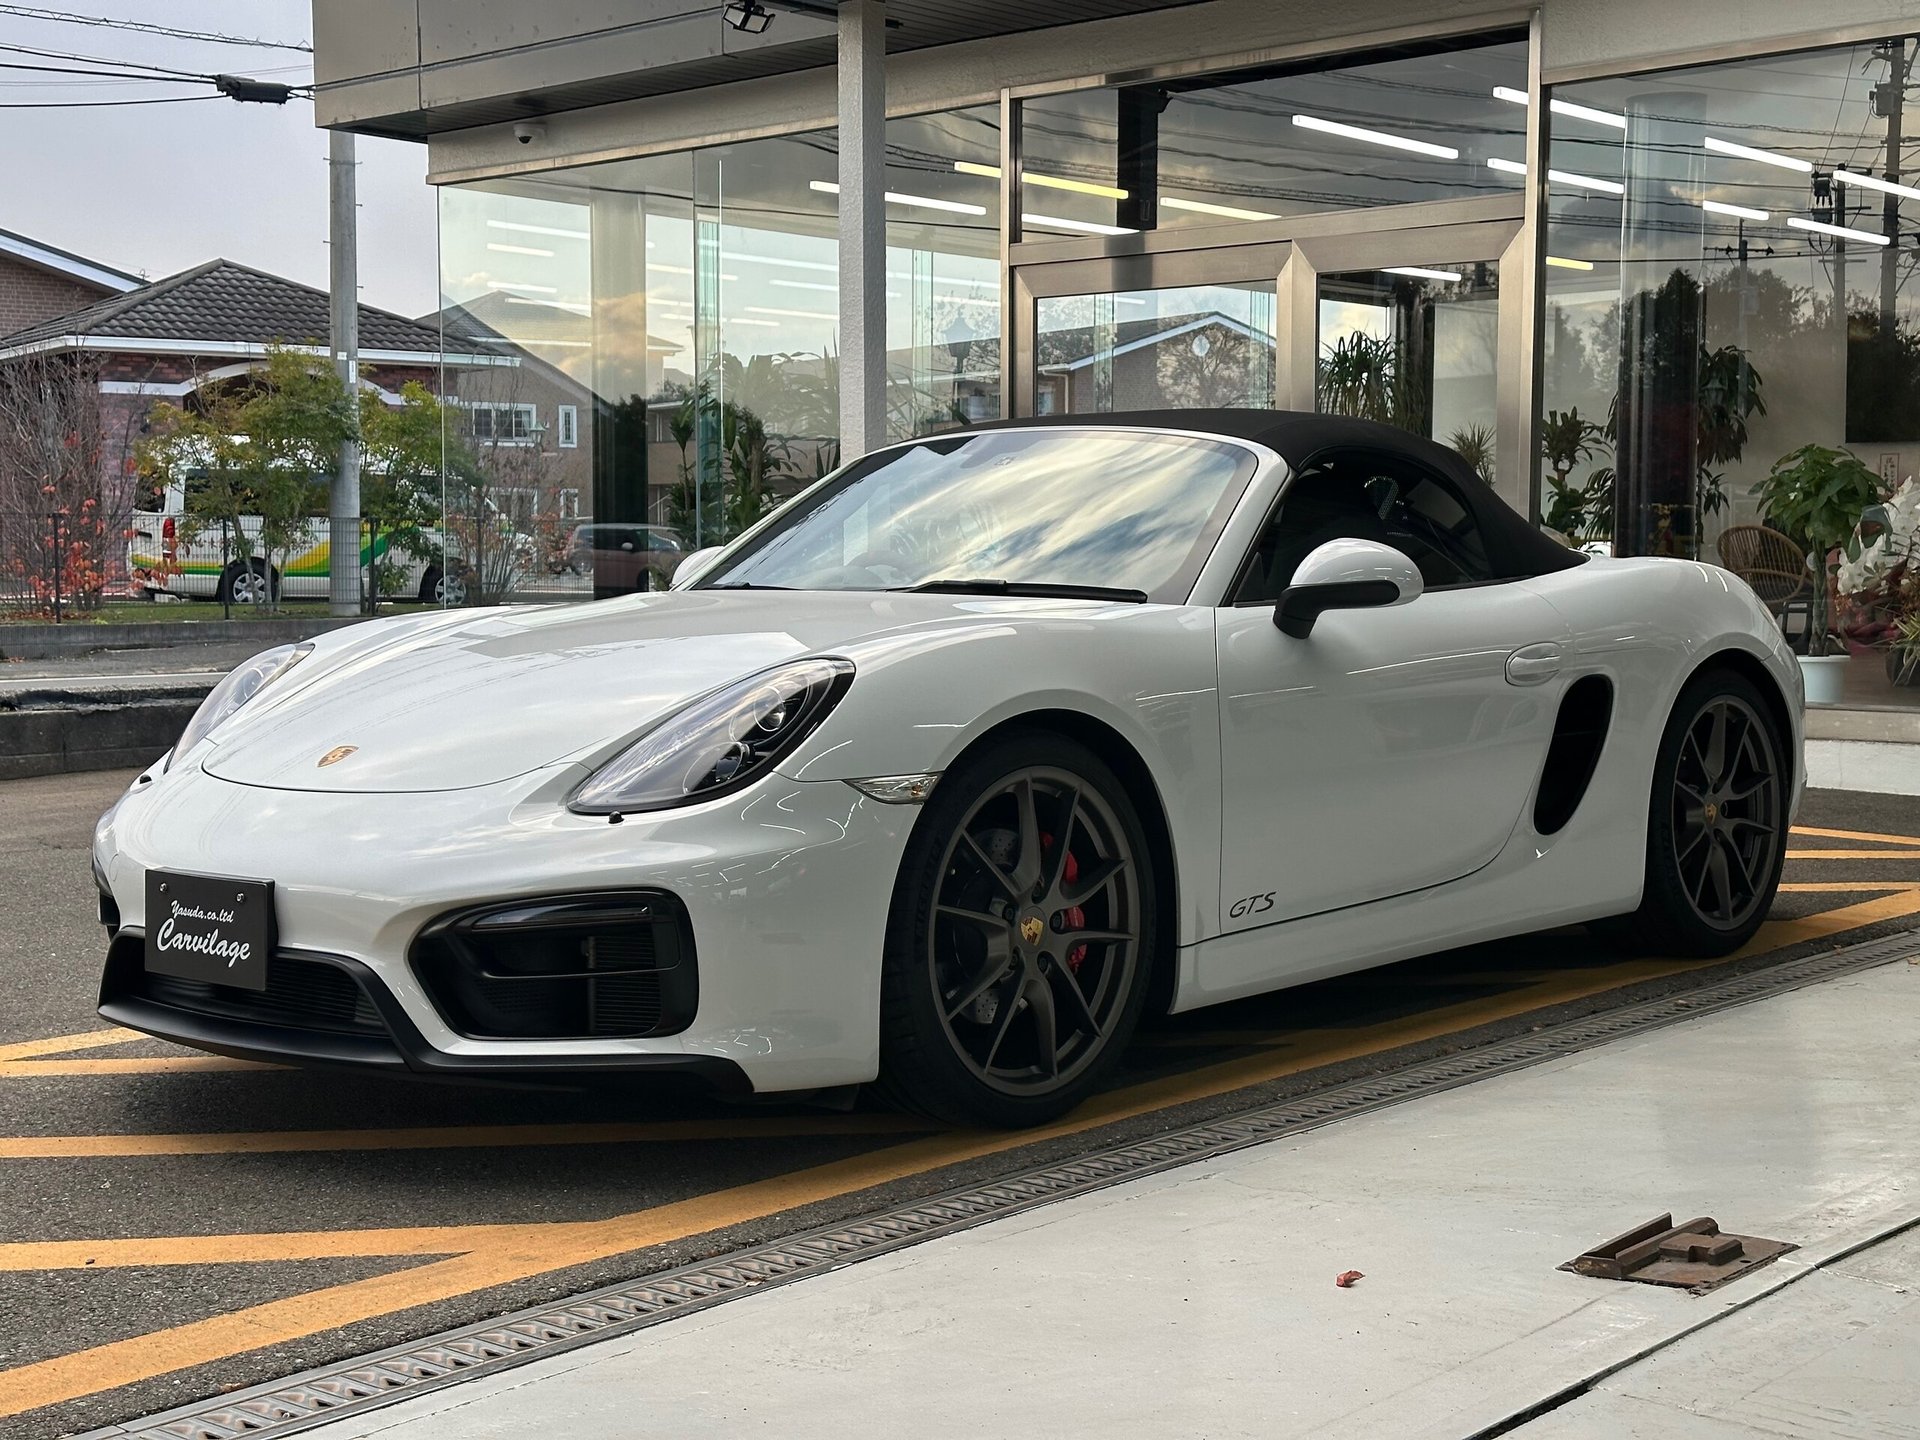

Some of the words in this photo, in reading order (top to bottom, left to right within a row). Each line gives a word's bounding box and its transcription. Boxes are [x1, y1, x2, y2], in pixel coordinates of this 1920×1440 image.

[171, 900, 234, 923] Yasuda.co.ltd
[1229, 891, 1277, 918] GTS
[157, 918, 251, 968] Carvilage
